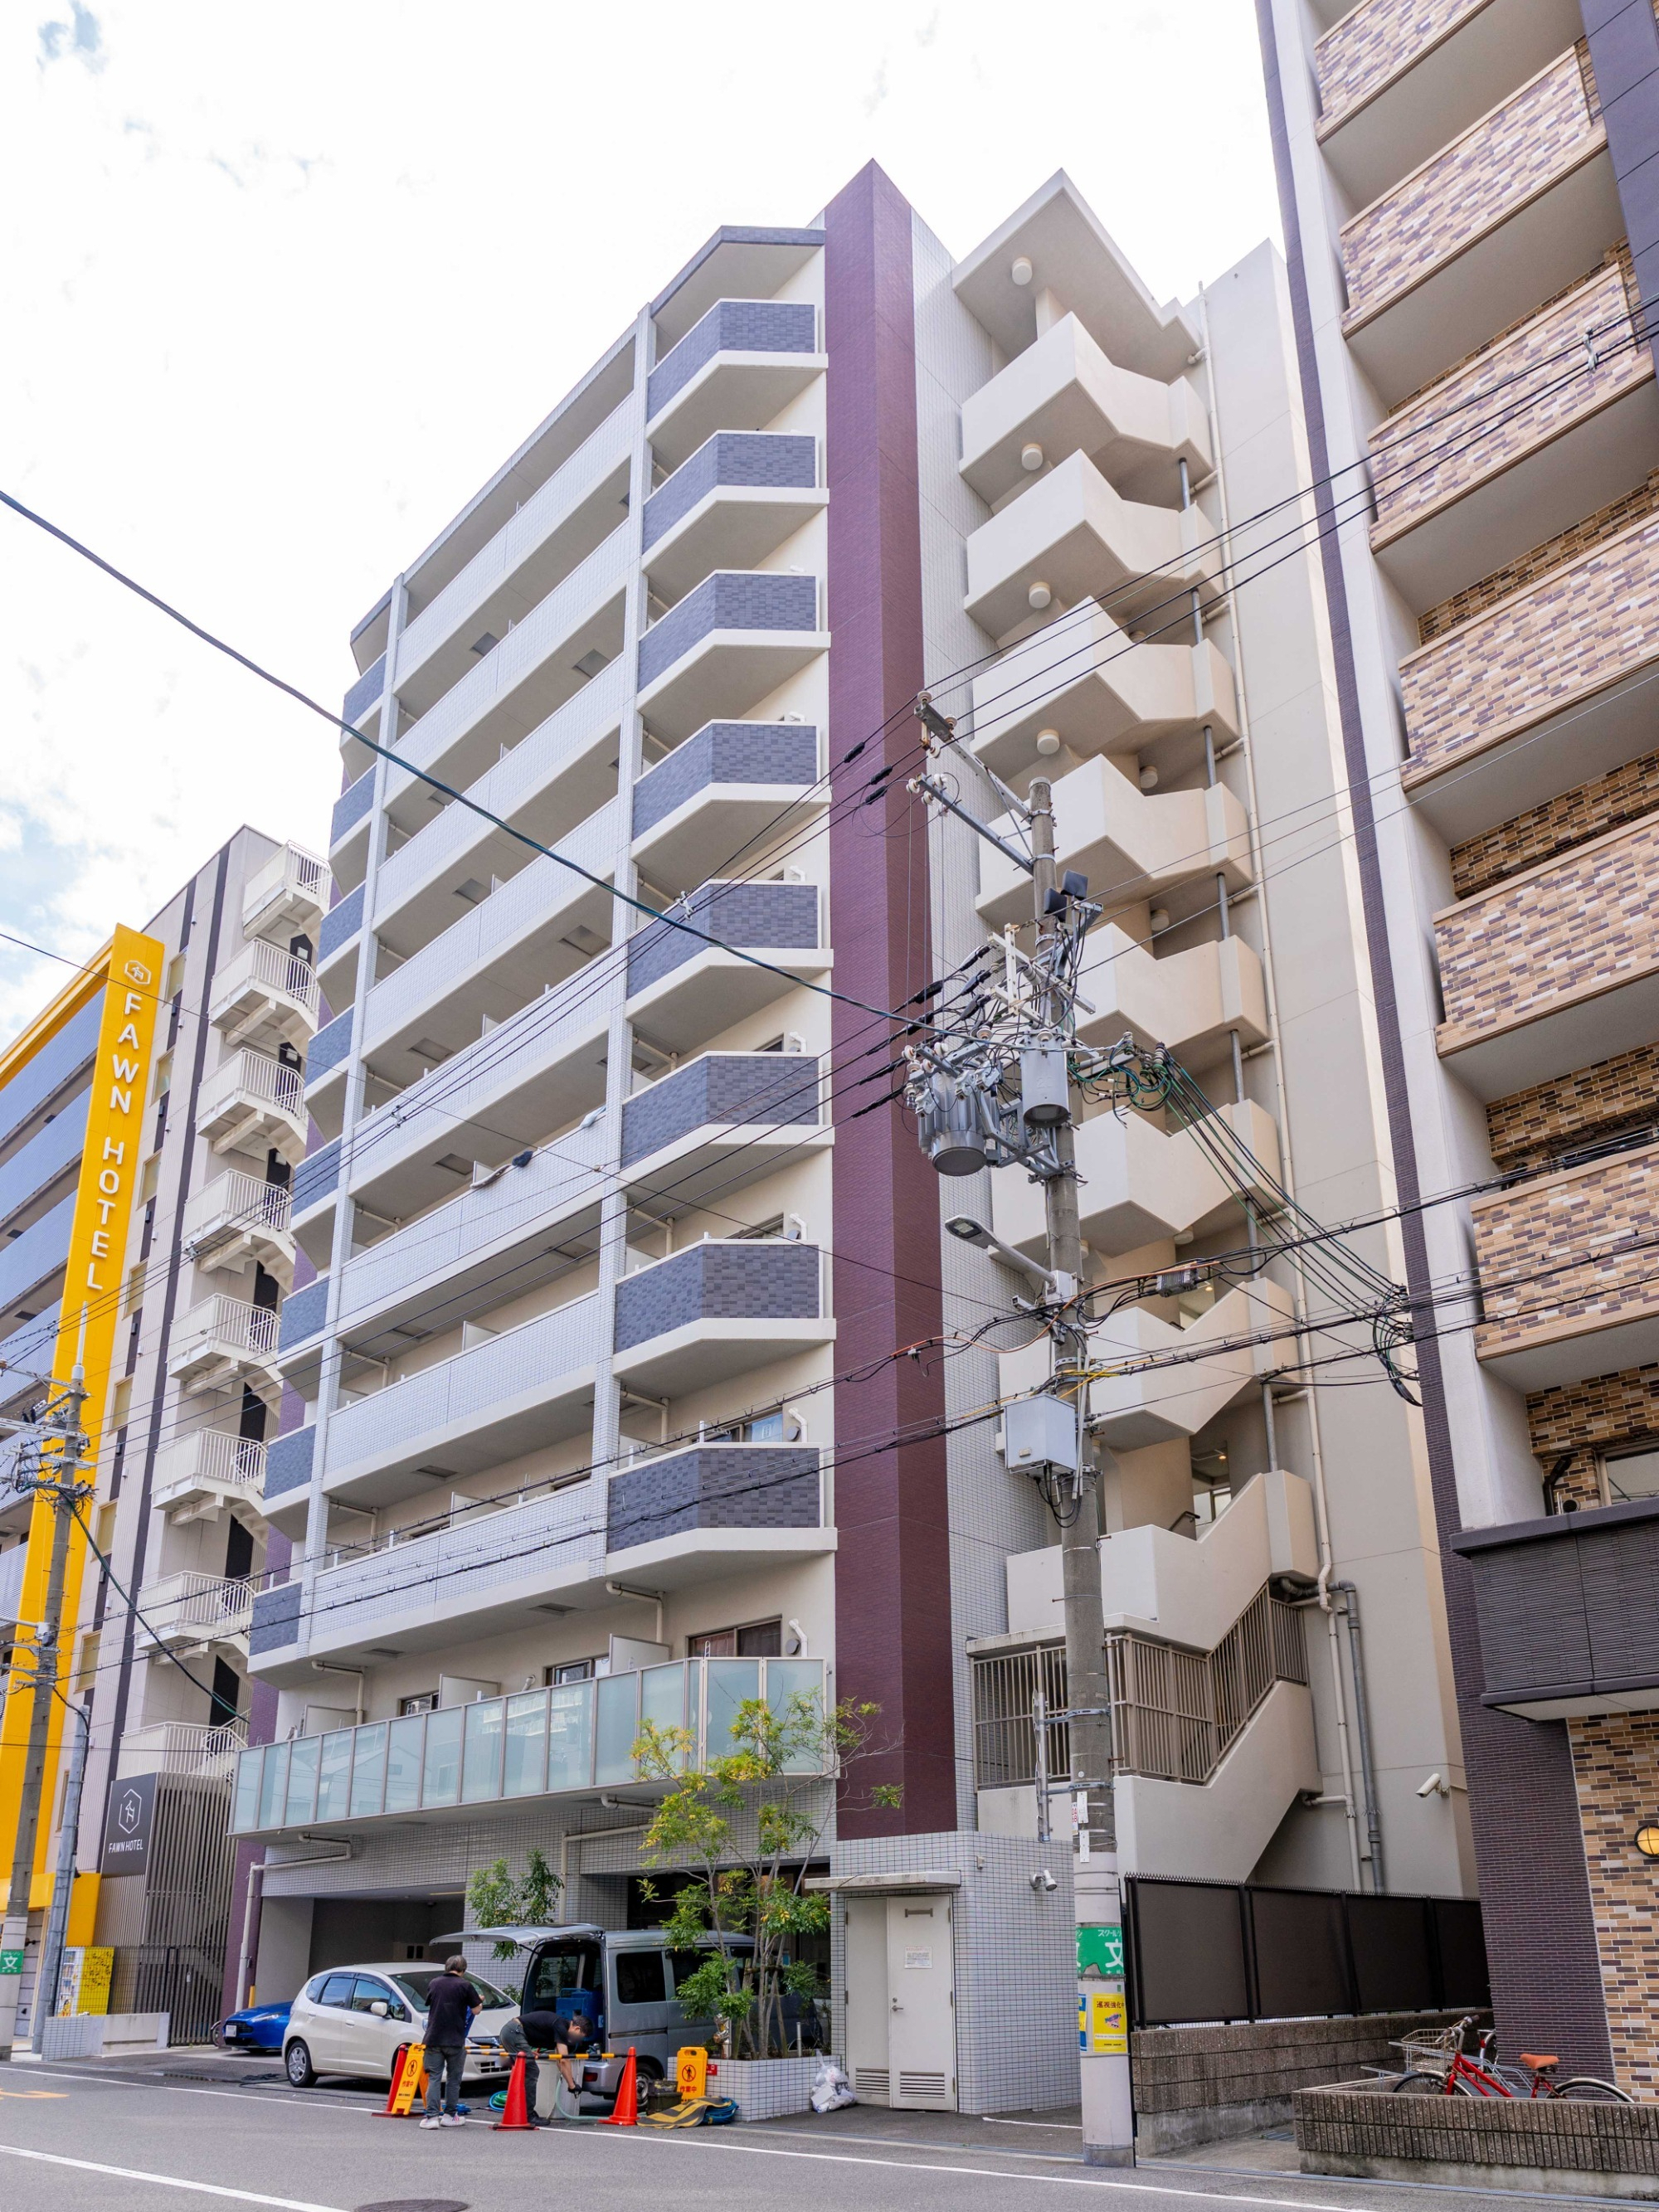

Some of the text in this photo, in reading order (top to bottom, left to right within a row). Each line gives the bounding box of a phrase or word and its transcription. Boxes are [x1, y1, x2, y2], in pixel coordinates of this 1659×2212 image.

[86, 992, 142, 1290] FAWN HOTEL
[109, 1839, 144, 1854] FAWN HOTEL
[2, 1955, 18, 1970] 文
[1105, 1938, 1123, 1967] 文
